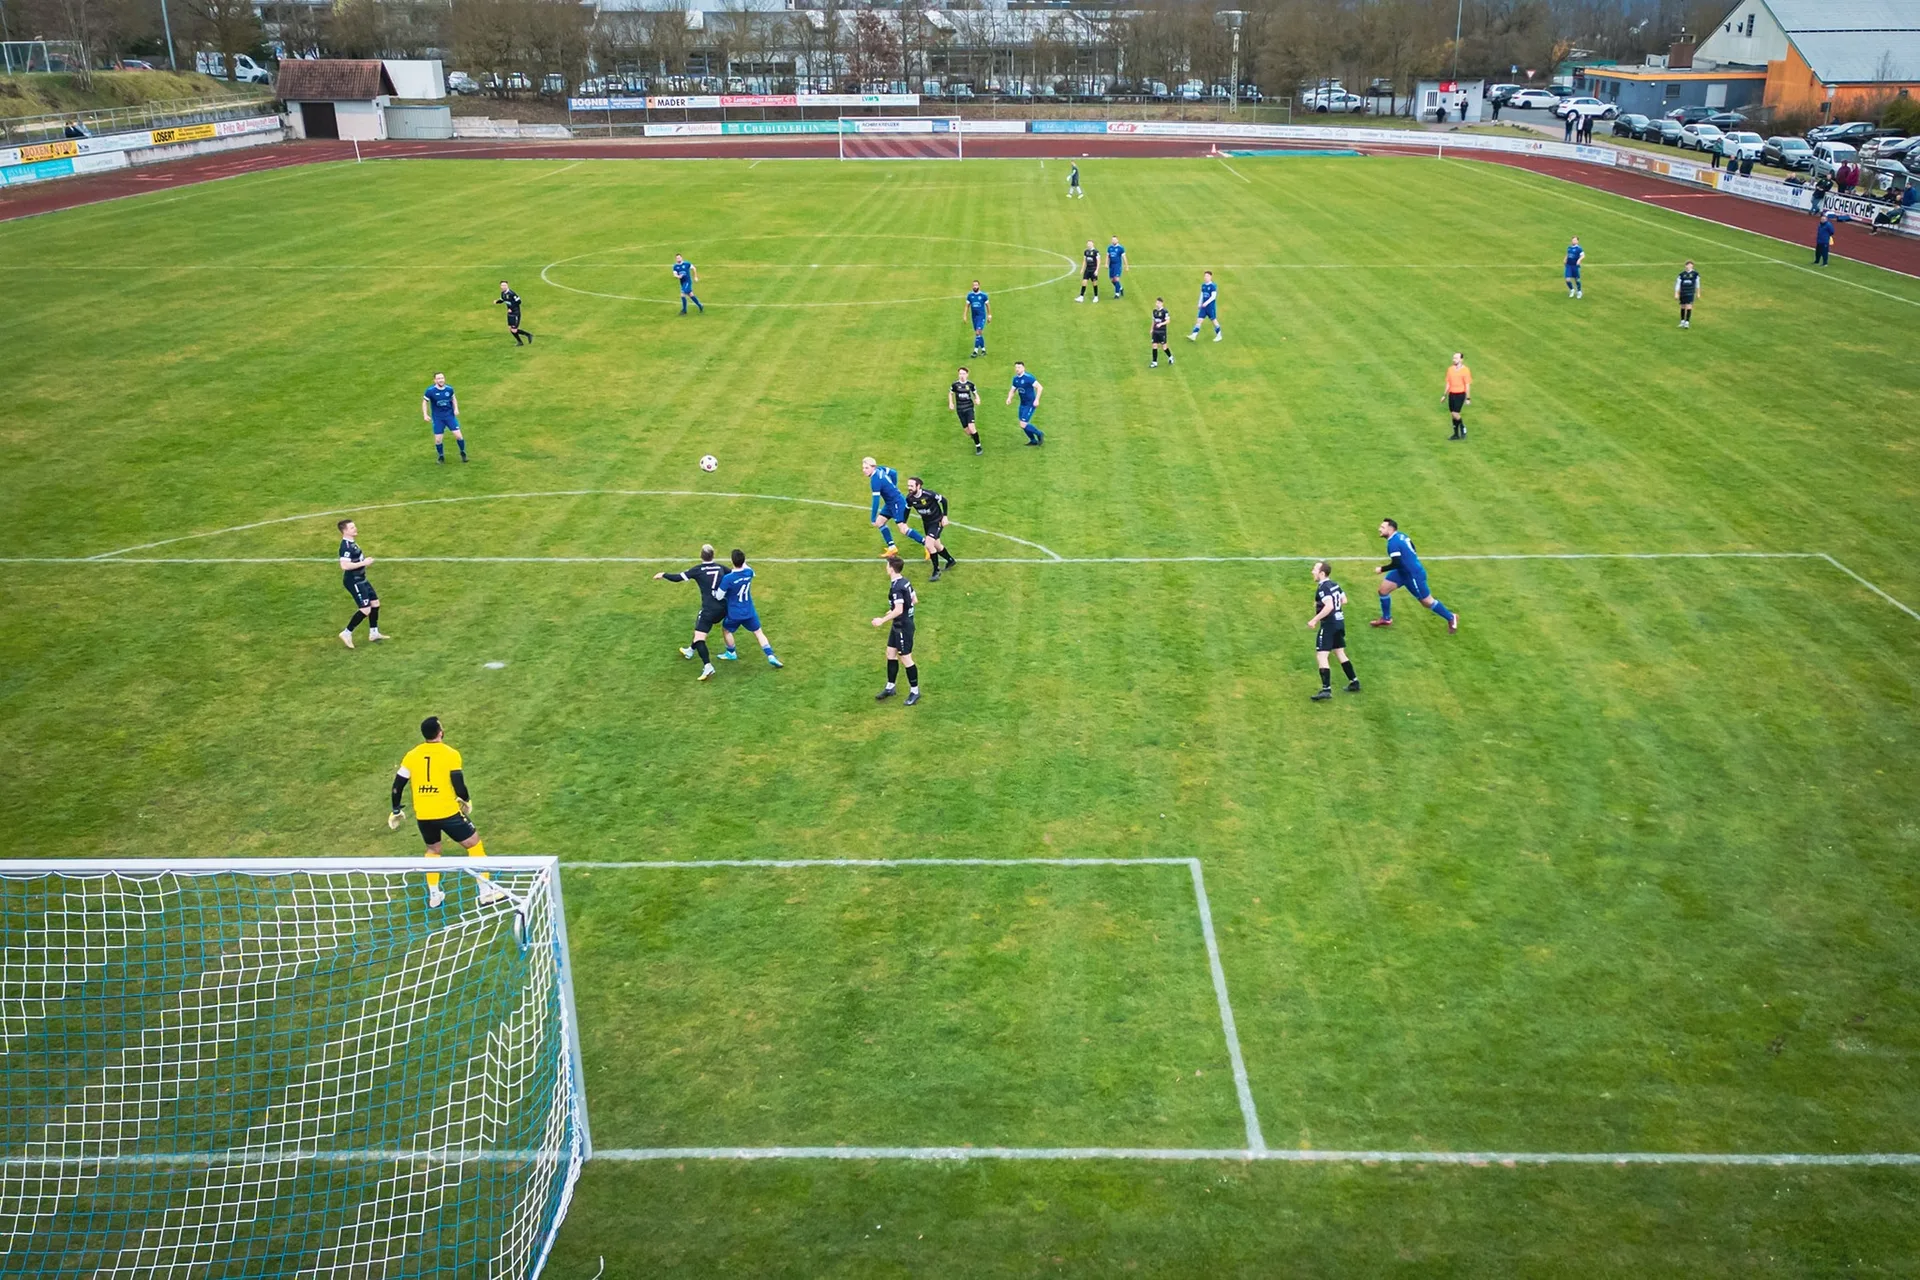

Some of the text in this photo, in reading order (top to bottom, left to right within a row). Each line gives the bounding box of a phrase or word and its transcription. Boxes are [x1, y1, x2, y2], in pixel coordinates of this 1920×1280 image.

[571, 98, 609, 107] BOGNER
[657, 98, 686, 107] MADER
[152, 131, 176, 143] LOSERT
[24, 146, 49, 158] BOXEN
[55, 142, 73, 155] STOP
[706, 571, 719, 589] 7
[736, 582, 751, 602] 11
[424, 756, 430, 782] 1
